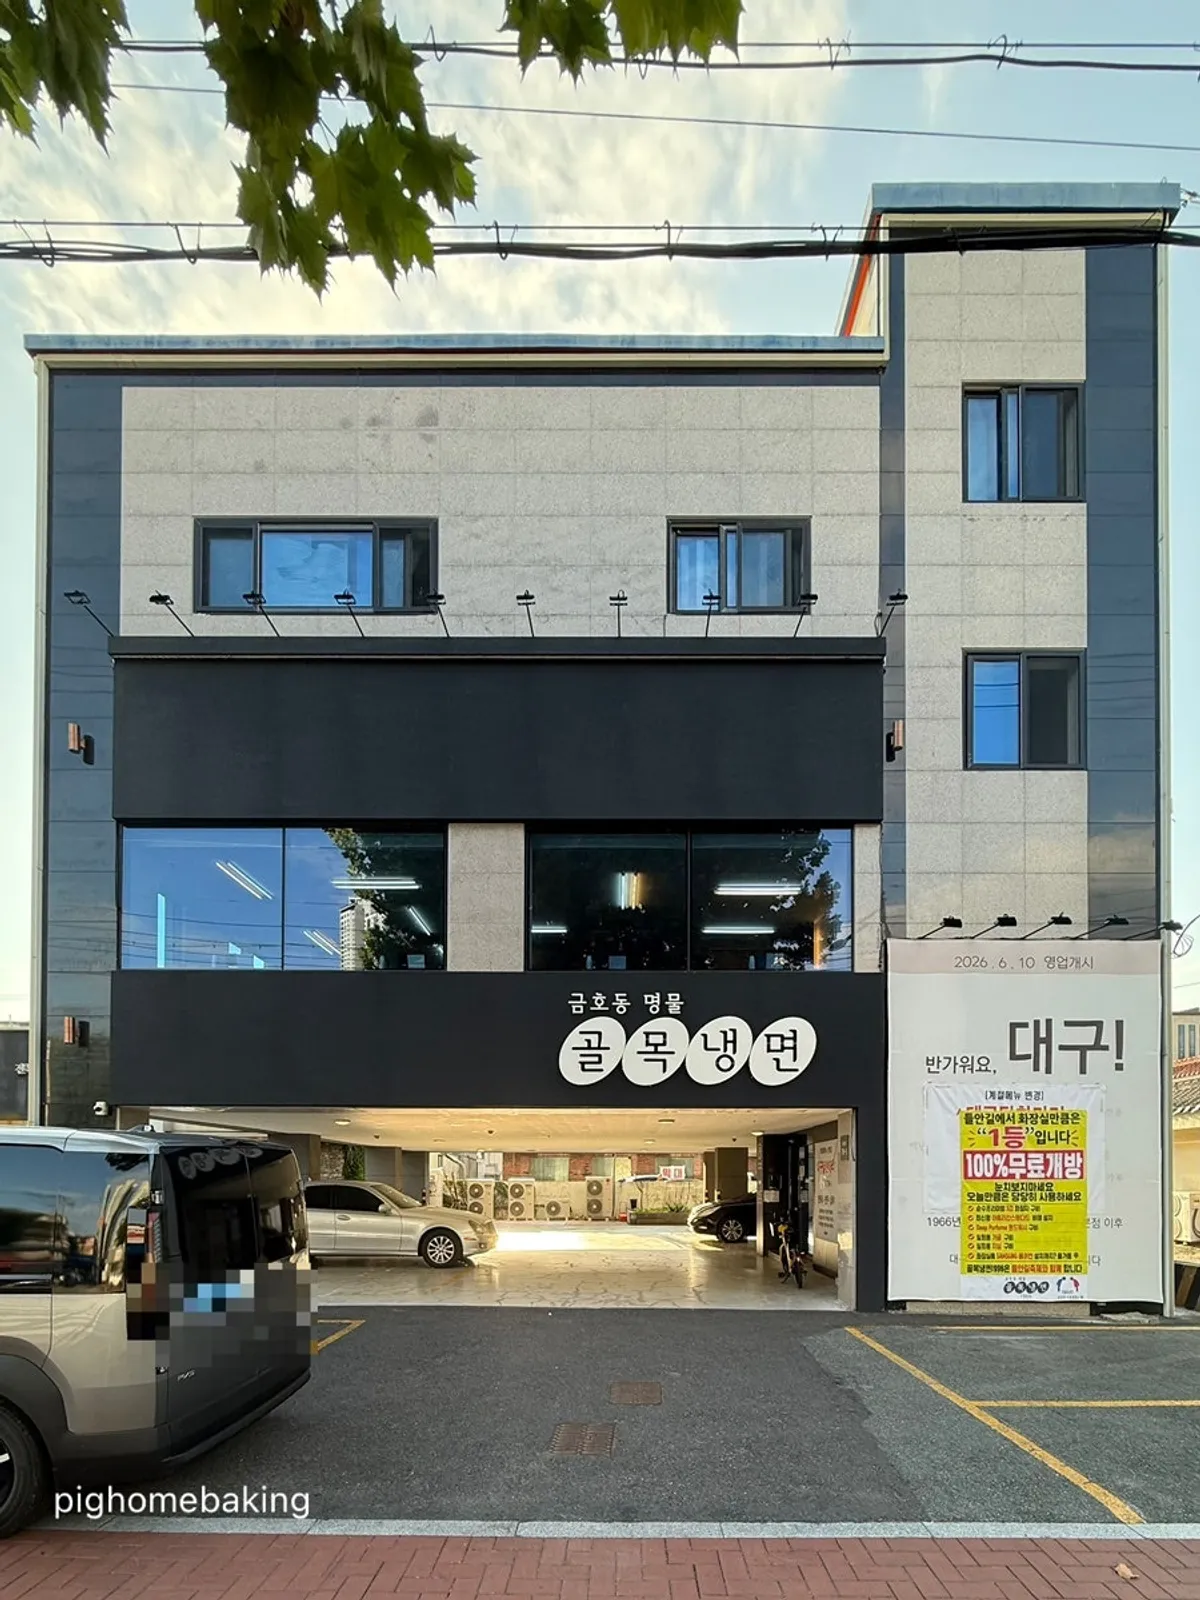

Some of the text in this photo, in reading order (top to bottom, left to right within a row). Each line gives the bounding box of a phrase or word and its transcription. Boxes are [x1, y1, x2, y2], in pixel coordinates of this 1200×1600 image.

[1043, 955, 1094, 970] 영업개시
[567, 992, 685, 1015] 금호동 명물
[570, 1027, 801, 1075] 골목냉면
[925, 1018, 1125, 1076] 반가워요, 대구!
[964, 1111, 1080, 1126] 들안길에서 화장실만큼은
[965, 1152, 1083, 1179] 100%무료개방
[1104, 1217, 1123, 1229] 이후
